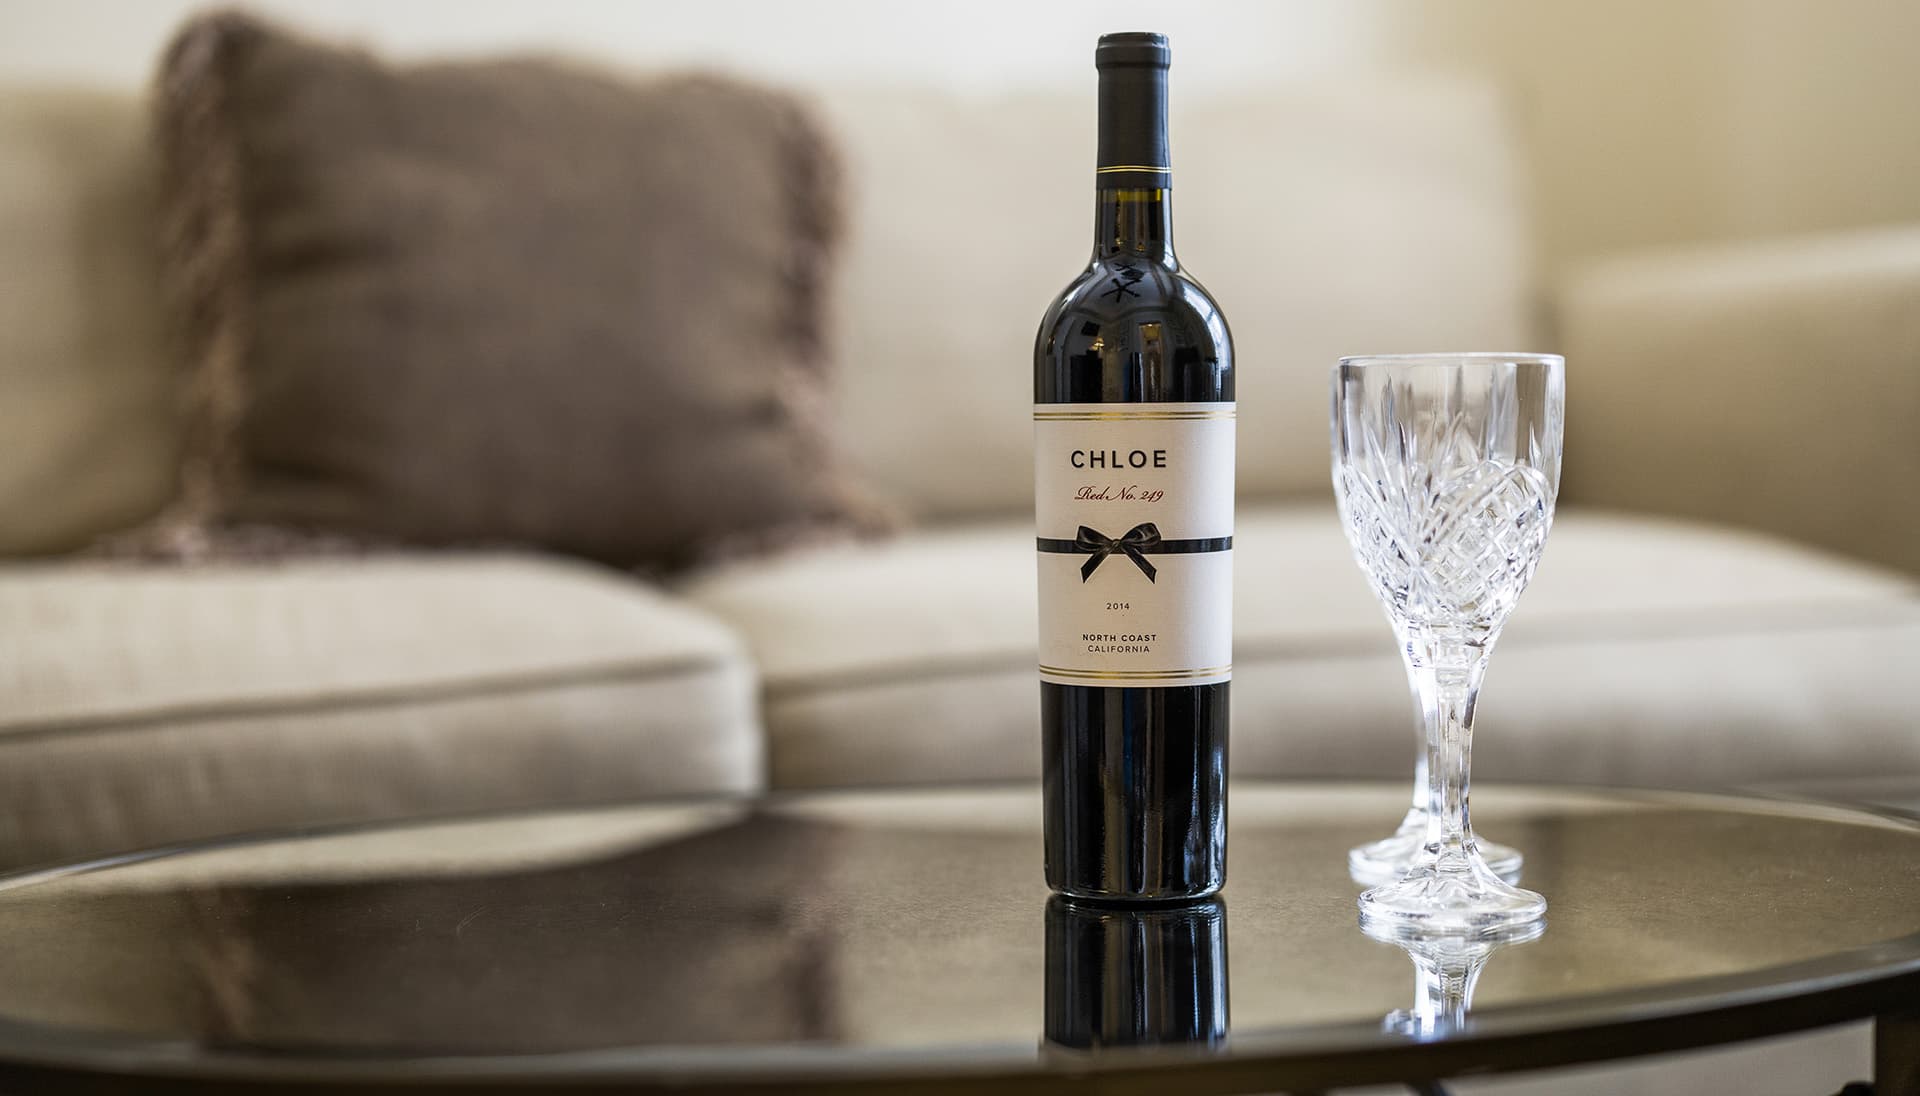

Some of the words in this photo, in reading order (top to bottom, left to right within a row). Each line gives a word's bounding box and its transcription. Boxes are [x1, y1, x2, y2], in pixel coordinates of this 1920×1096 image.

[1070, 449, 1167, 469] CHLOE
[1074, 486, 1110, 501] Red
[1106, 485, 1137, 502] No.
[1140, 490, 1164, 503] 249
[1106, 602, 1130, 610] 2014
[1082, 633, 1117, 642] NORTH
[1120, 634, 1157, 642] COAST
[1087, 645, 1150, 653] CALIFORNIA
